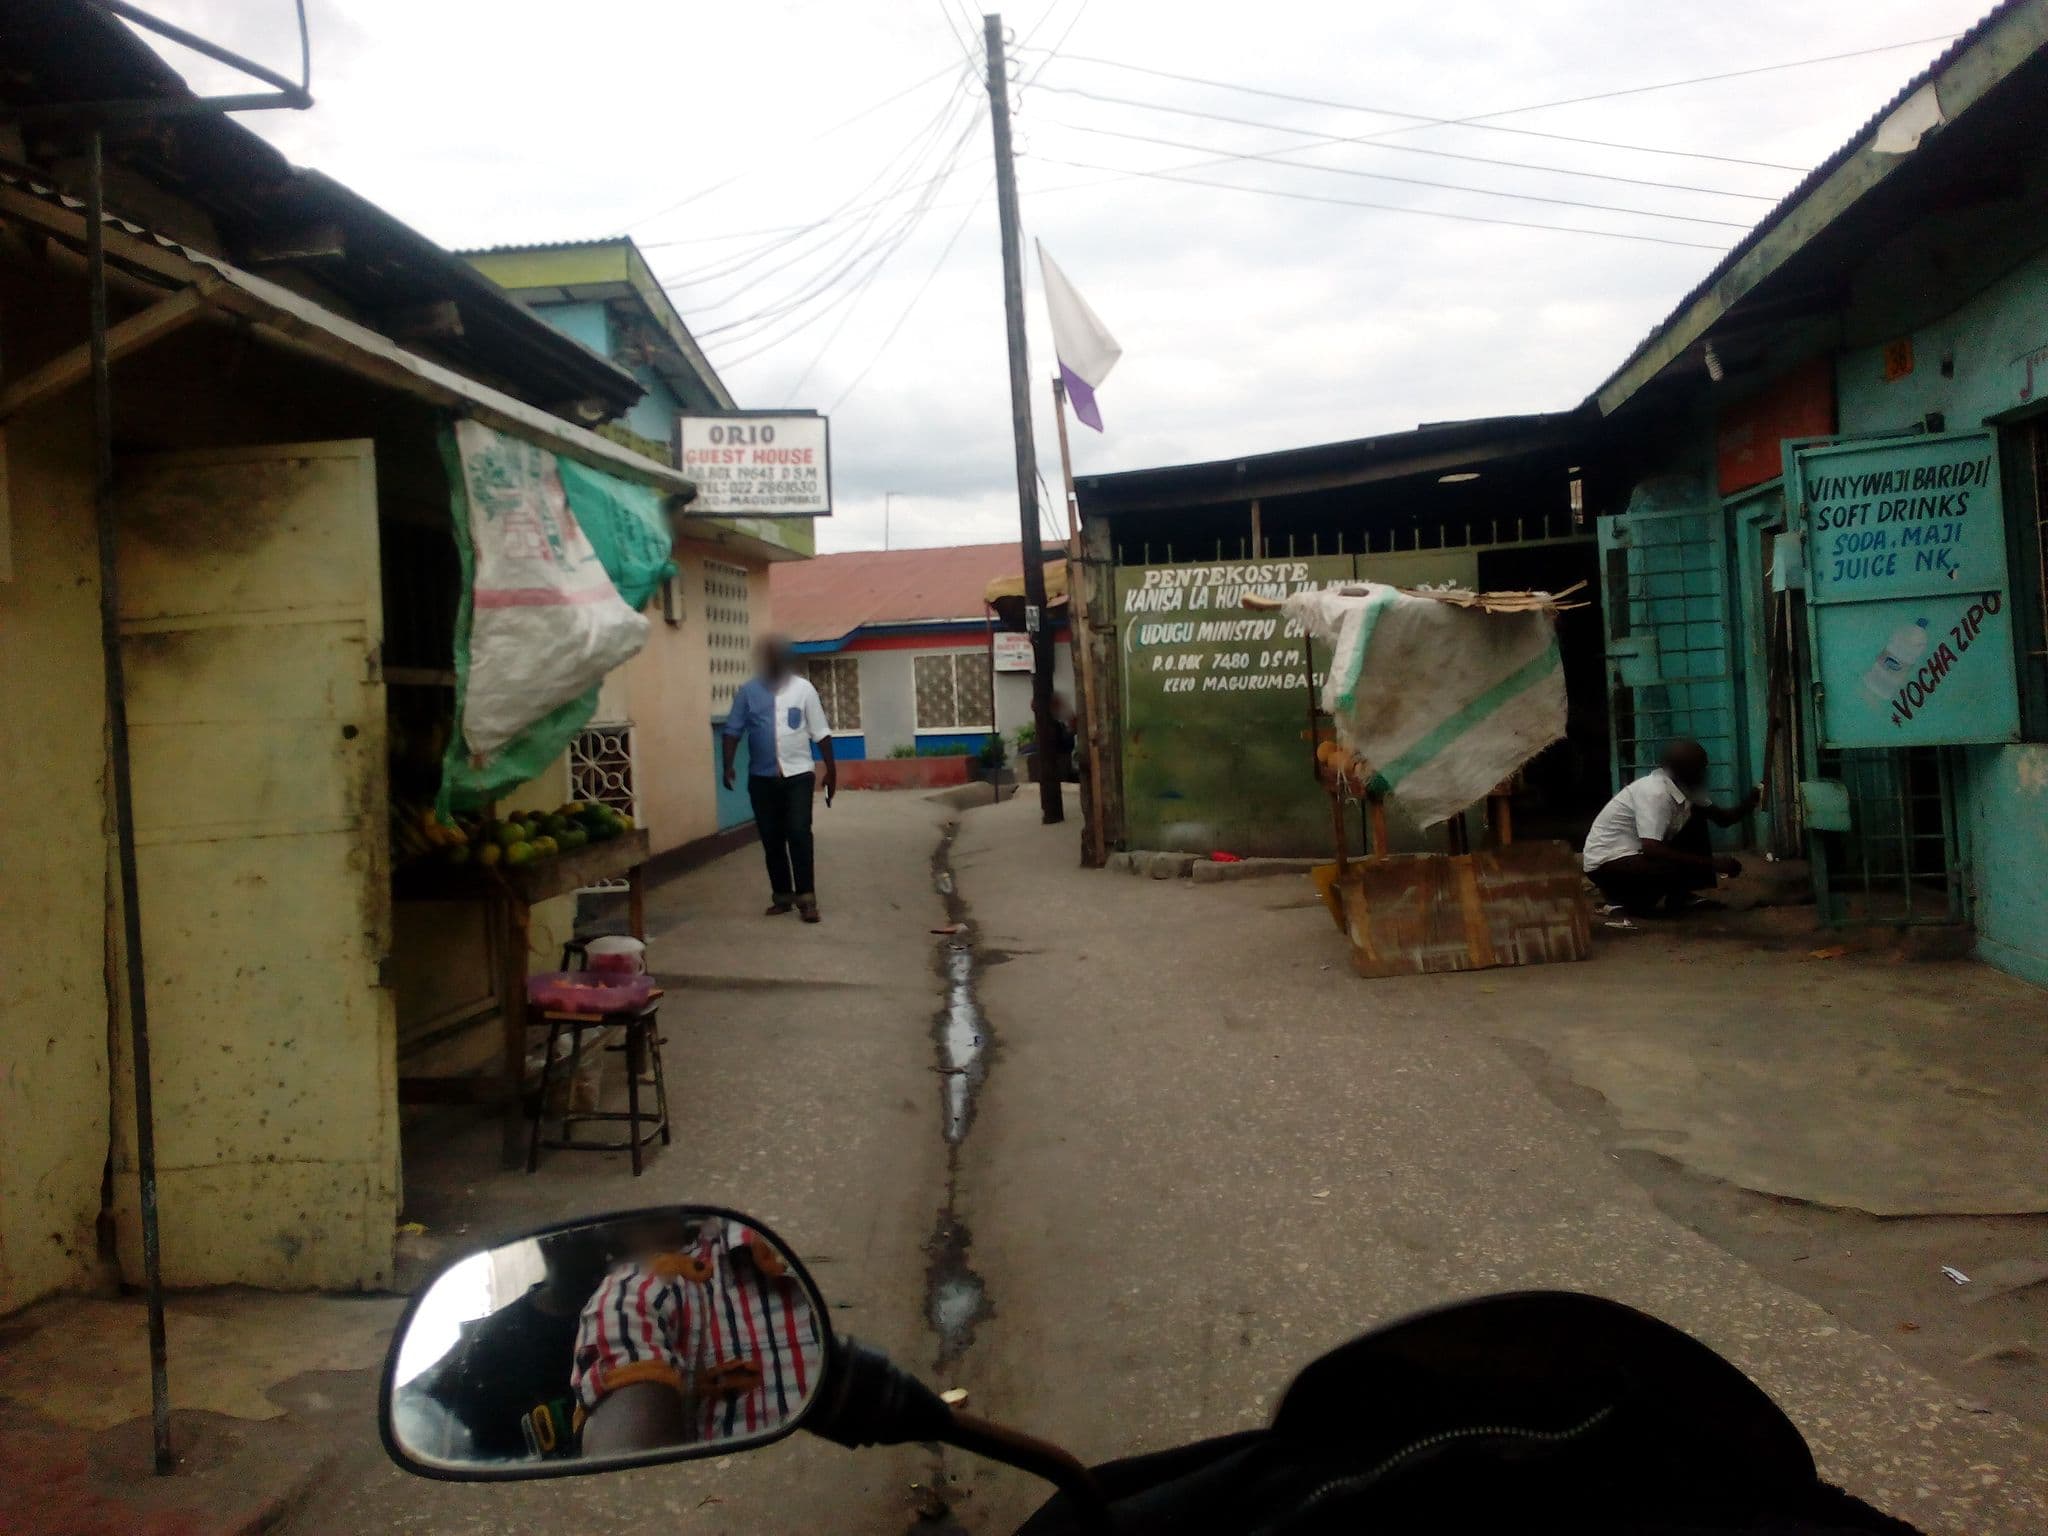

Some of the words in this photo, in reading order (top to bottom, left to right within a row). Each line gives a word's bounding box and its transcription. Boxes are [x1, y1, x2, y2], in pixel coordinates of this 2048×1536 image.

[709, 425, 776, 445] ORIO
[686, 448, 745, 464] GUEST
[752, 447, 814, 464] HOUSE
[1808, 468, 1911, 502] VINYWAJI
[1817, 503, 1872, 531] SOFT
[1877, 491, 1970, 523] DRINKS
[1901, 522, 1963, 547] MAJI
[1143, 562, 1309, 590] PENTEKOSTE
[1833, 553, 1898, 582] JUICE
[1124, 586, 1184, 613] KANISA
[1188, 586, 1208, 610] LA
[1197, 619, 1276, 642] MINISTRY
[1950, 592, 2002, 652] ZIPO
[1212, 652, 1250, 670] 7480
[1163, 676, 1196, 692] KEKO
